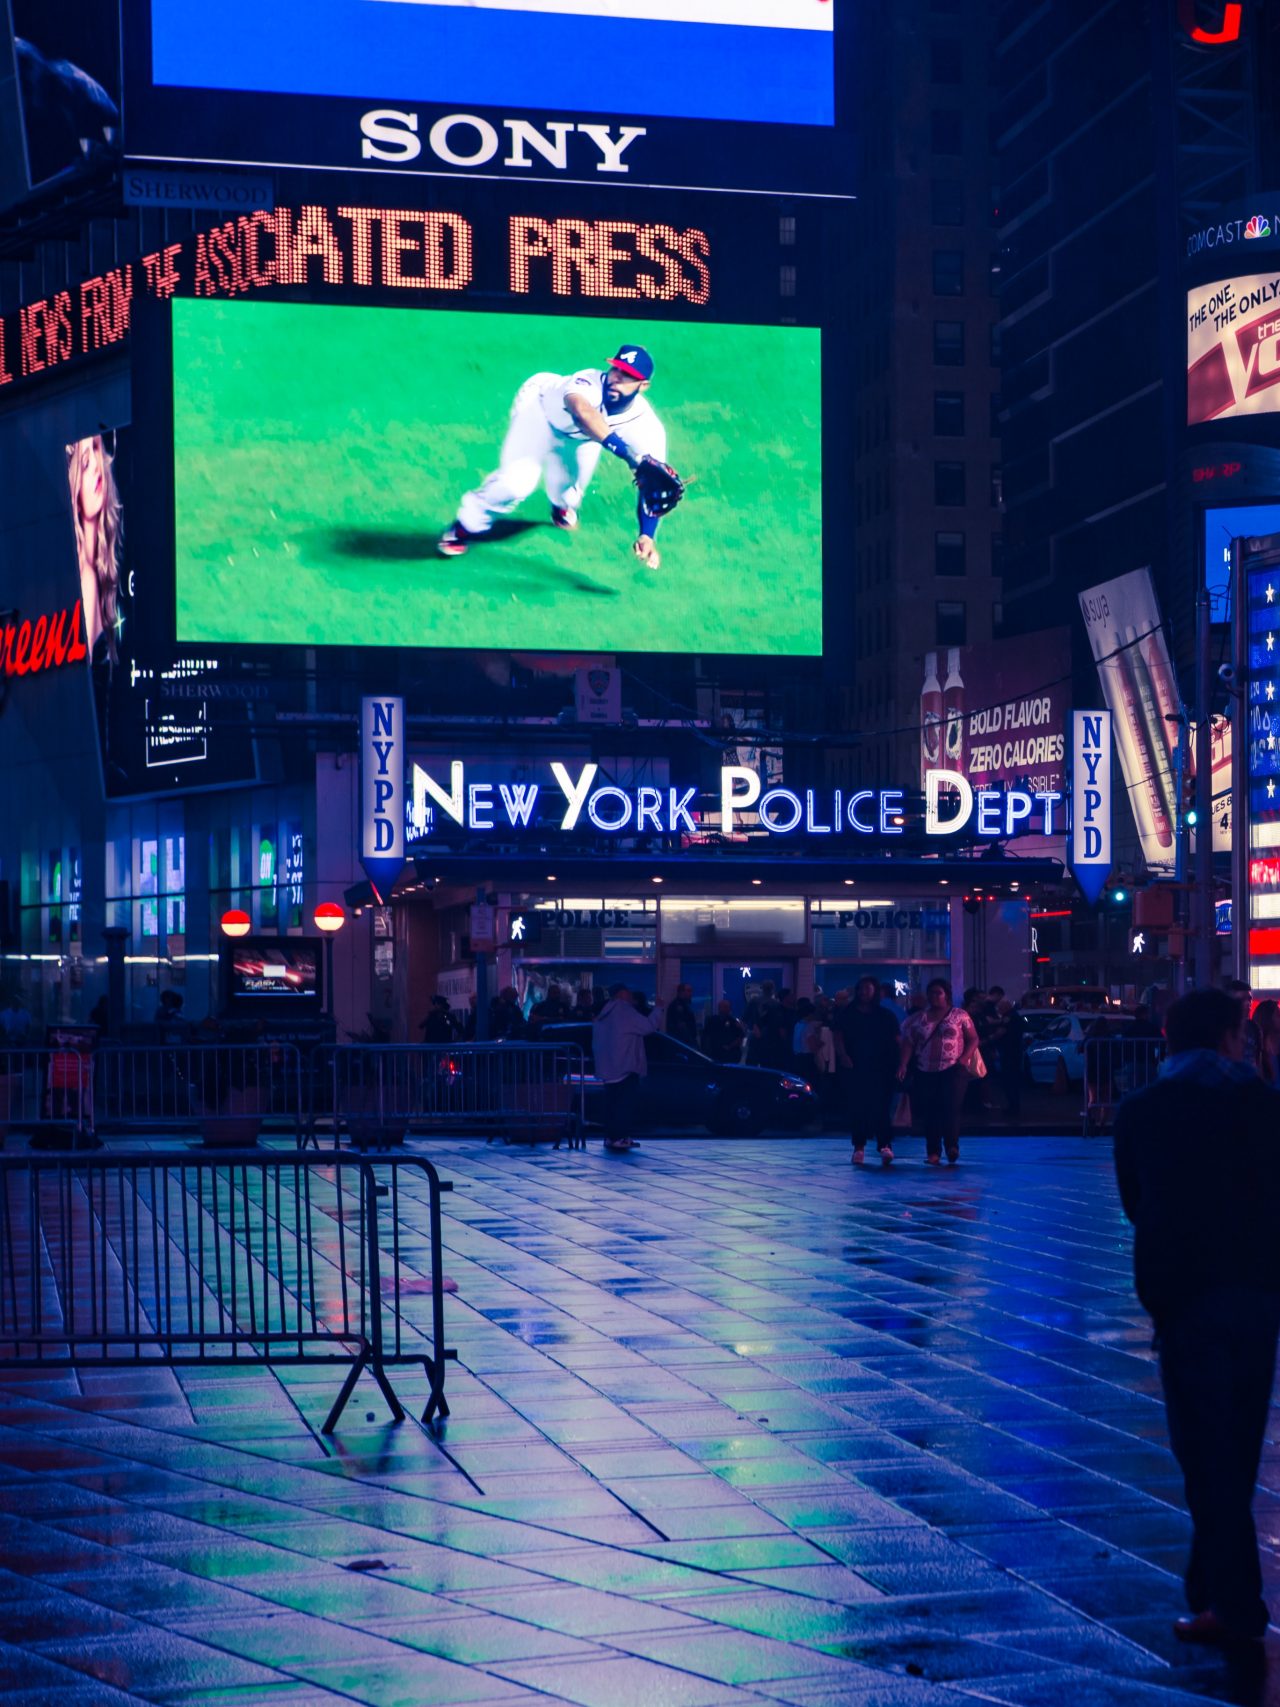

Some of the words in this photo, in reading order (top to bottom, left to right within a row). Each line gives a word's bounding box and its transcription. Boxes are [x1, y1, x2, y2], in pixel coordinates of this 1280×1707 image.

[360, 109, 646, 171] SONY
[128, 176, 267, 204] SHERWOOD
[1187, 220, 1243, 257] COMCAST
[20, 291, 72, 376] NEWS
[80, 265, 133, 352] FROM
[142, 244, 182, 299] THE
[195, 205, 472, 296] ASSOCIATED
[509, 215, 710, 305] PRESS
[1190, 304, 1207, 332] THE
[1209, 284, 1235, 315] ONE.
[1214, 303, 1236, 332] THE
[0, 599, 87, 677] reens
[160, 681, 269, 698] SHERWOOD
[969, 706, 1001, 735] BOLD
[1004, 697, 1051, 730] FLAVOR
[969, 744, 1002, 773] ZERO
[1003, 734, 1065, 768] CALORIES
[372, 702, 395, 852] NYPD
[1083, 716, 1103, 859] NYPD
[542, 910, 629, 928] POLICE
[839, 911, 923, 928] POLICE
